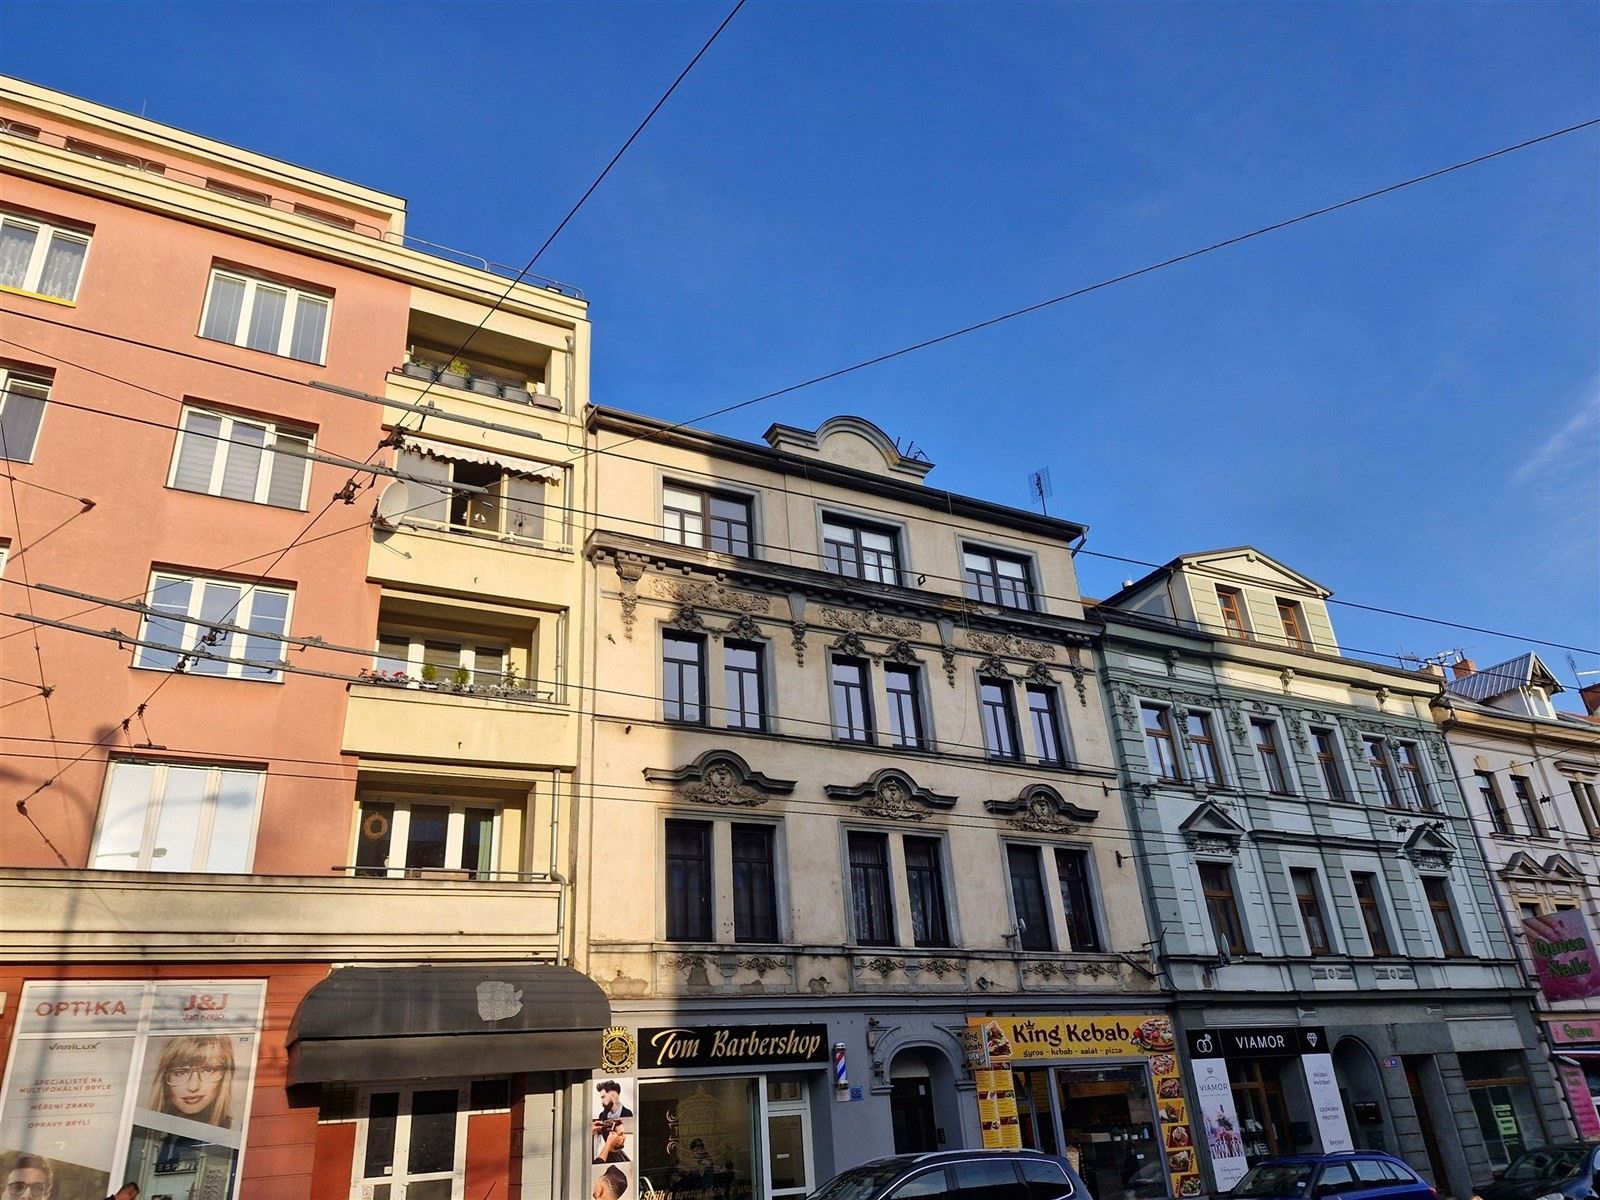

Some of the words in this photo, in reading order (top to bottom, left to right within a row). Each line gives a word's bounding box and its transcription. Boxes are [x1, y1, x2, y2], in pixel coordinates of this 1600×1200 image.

[35, 1000, 128, 1017] OPTIKA
[183, 994, 228, 1010] J&J
[1012, 1021, 1062, 1048] King
[1065, 1022, 1130, 1044] Kebab
[651, 1029, 700, 1066] Tom
[710, 1030, 821, 1059] Barbershop
[1235, 1035, 1286, 1049] VIAMOR
[1051, 1047, 1073, 1056] kebab
[1105, 1047, 1123, 1056] pizza
[1198, 1082, 1228, 1092] VIAMOR
[66, 1102, 95, 1110] ZRAKU
[27, 1120, 62, 1129] OPRAVY
